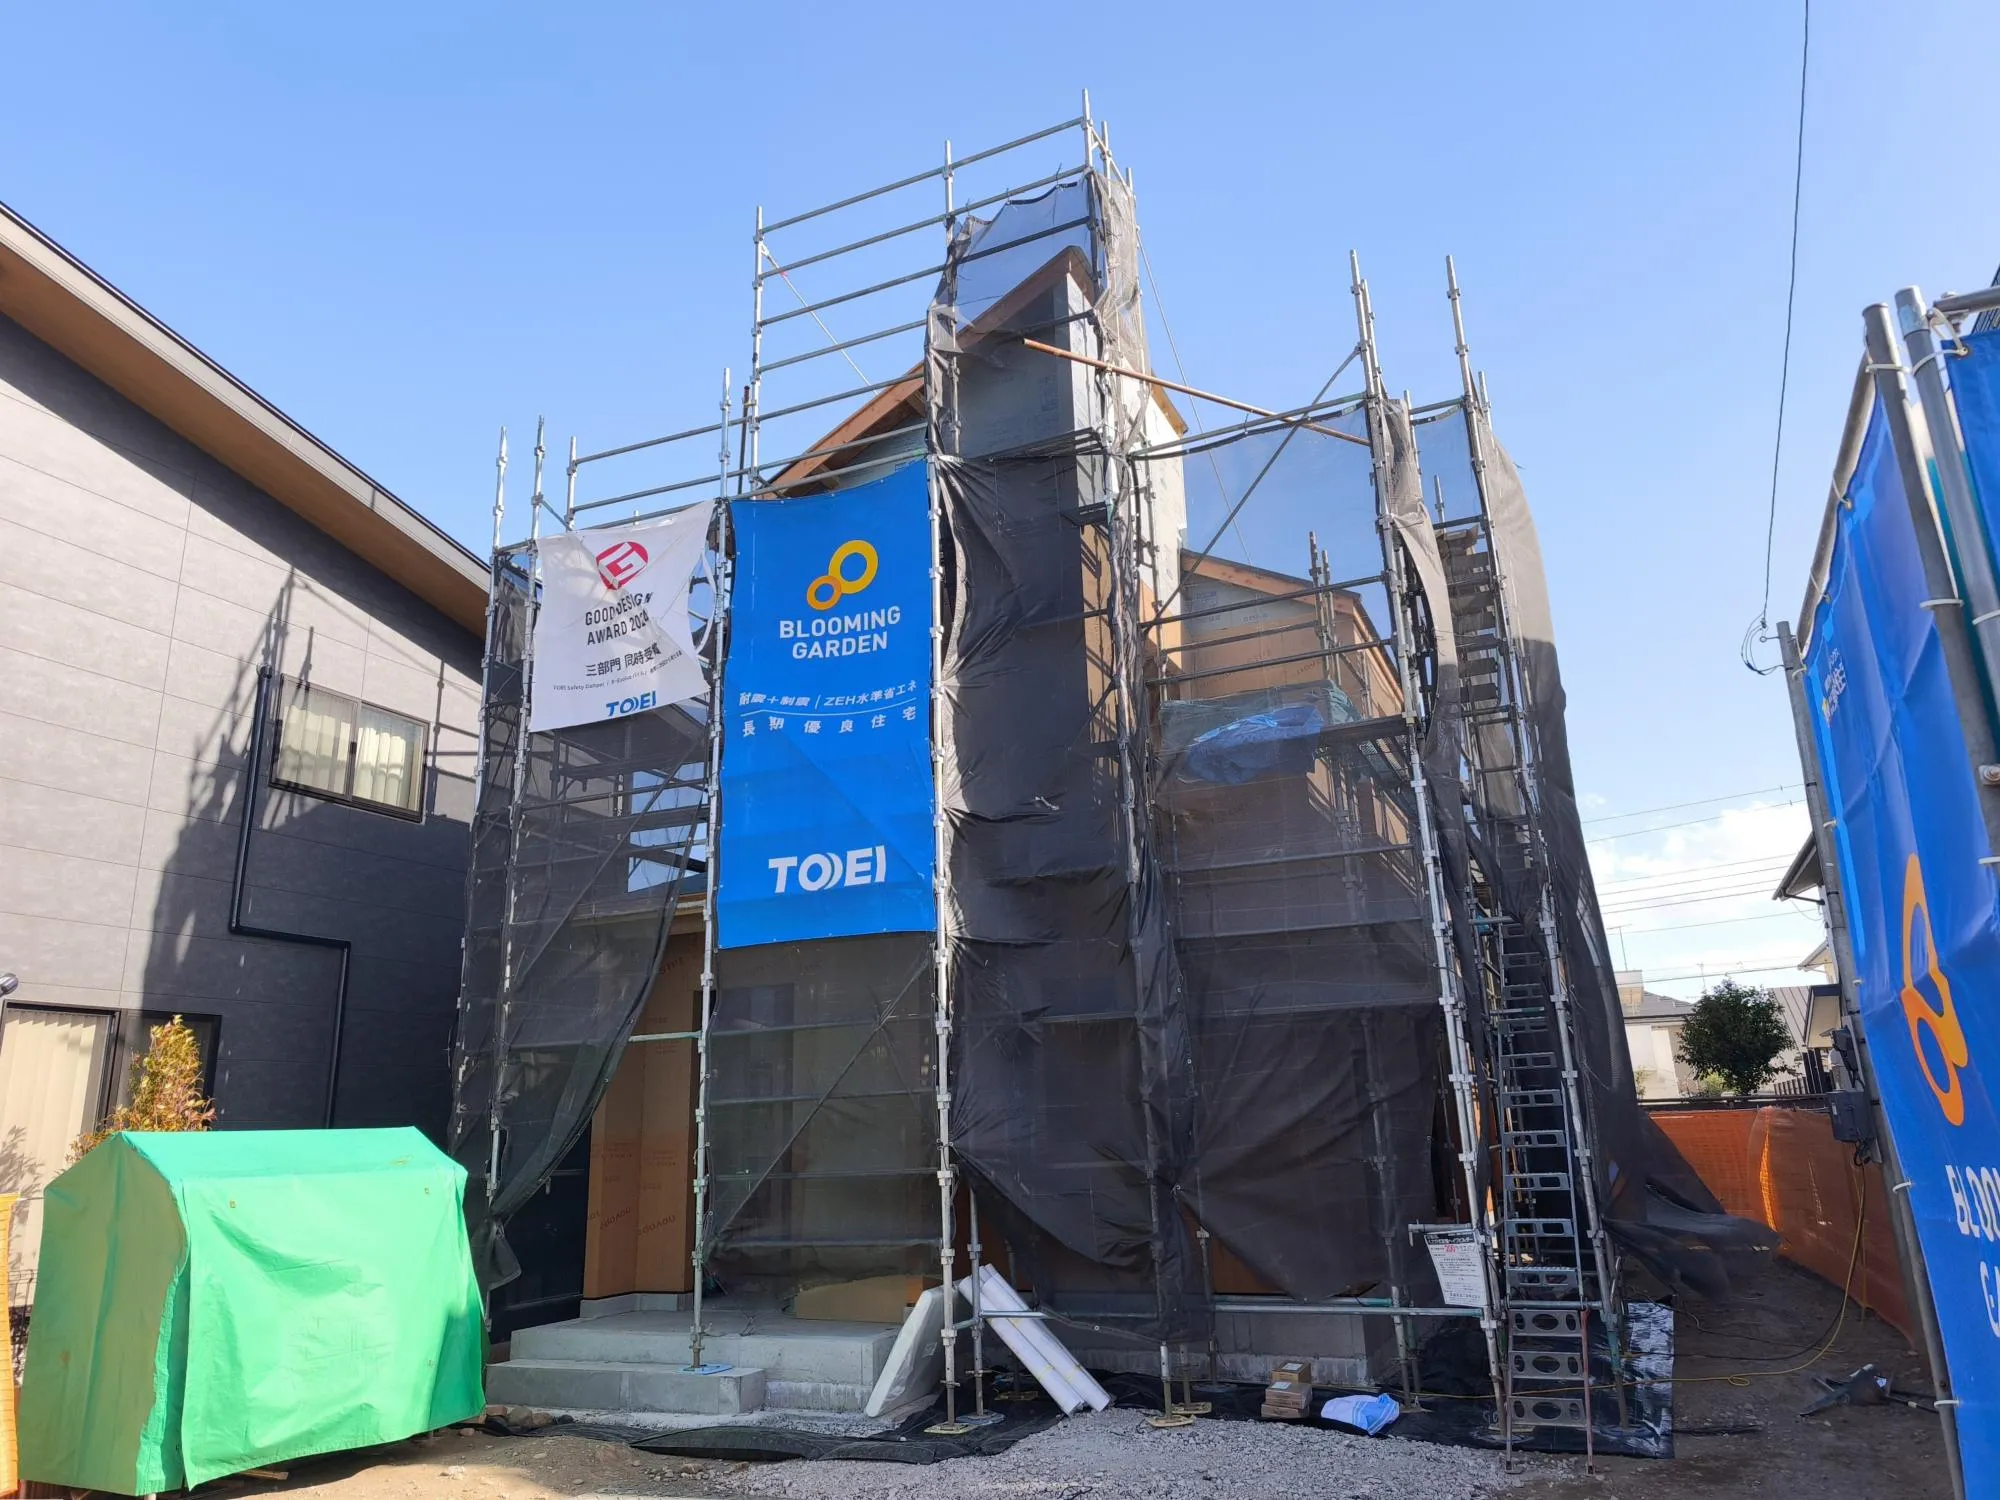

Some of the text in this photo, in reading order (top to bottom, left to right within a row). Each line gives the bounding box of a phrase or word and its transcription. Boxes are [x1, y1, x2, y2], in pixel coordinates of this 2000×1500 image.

[587, 620, 628, 646] AWARD
[779, 605, 901, 639] BLOOMING
[792, 631, 888, 660] GARDEN
[585, 657, 622, 677] 三部門
[1979, 1261, 2000, 1338] G
